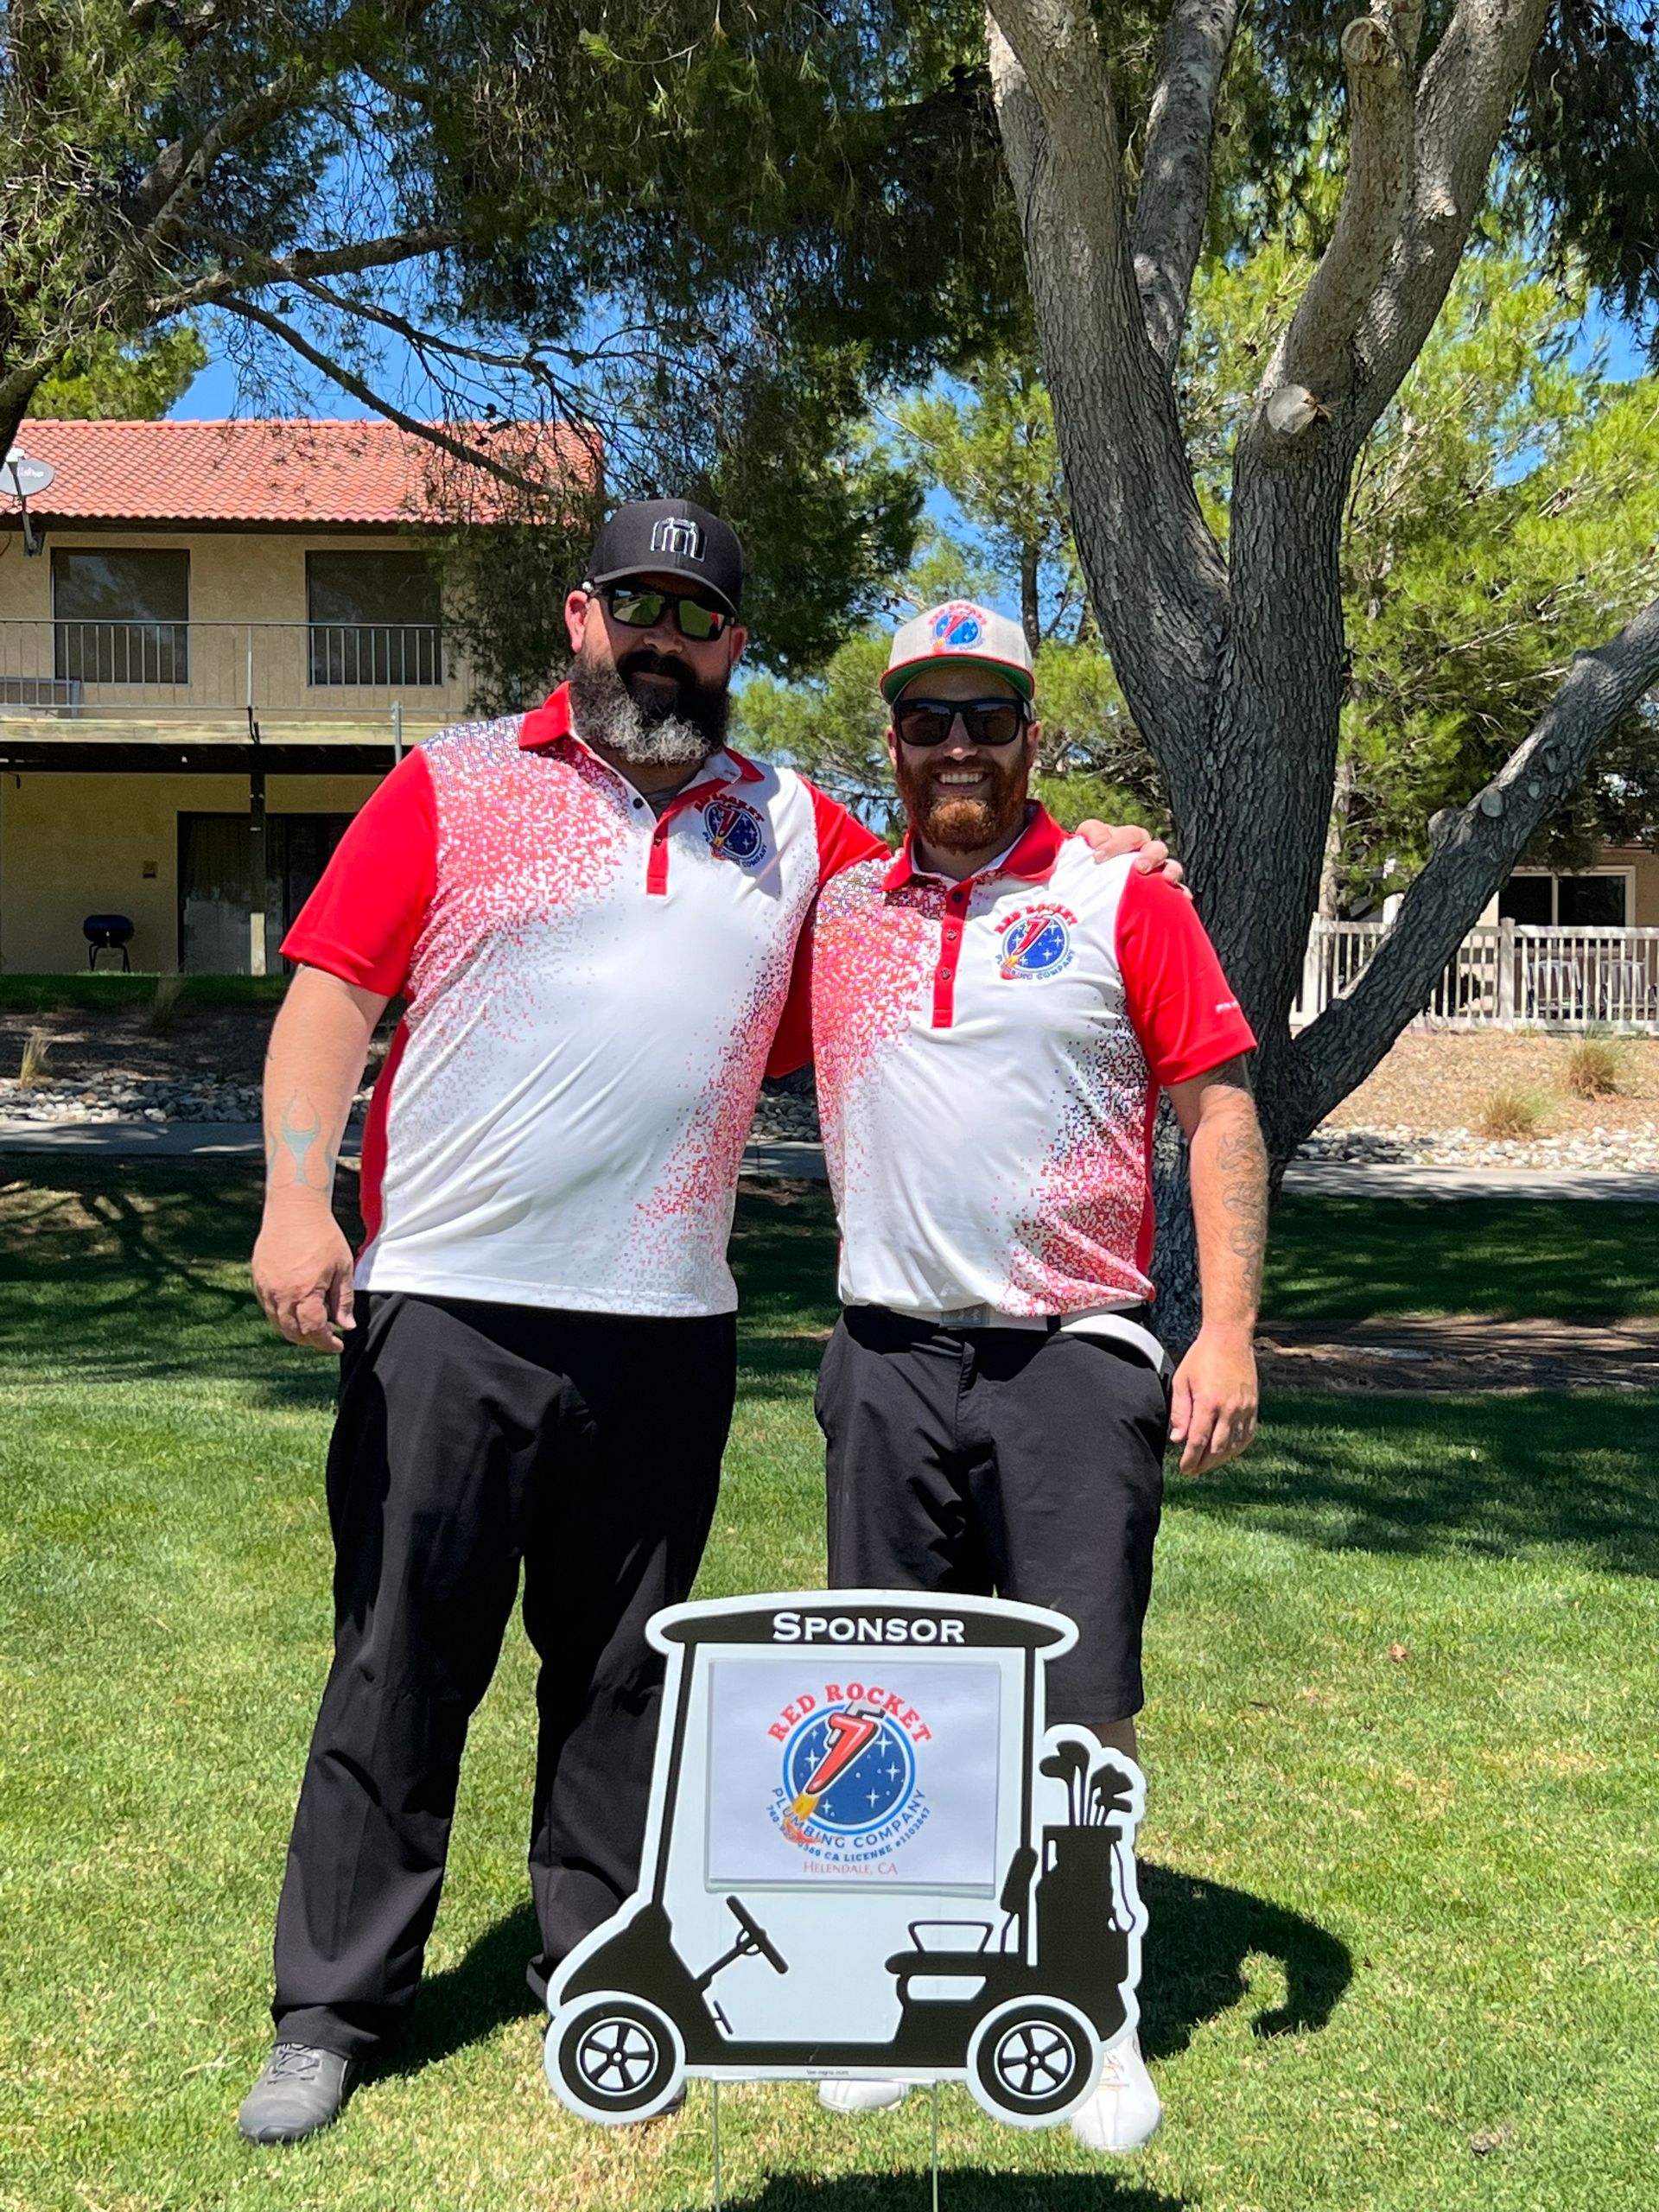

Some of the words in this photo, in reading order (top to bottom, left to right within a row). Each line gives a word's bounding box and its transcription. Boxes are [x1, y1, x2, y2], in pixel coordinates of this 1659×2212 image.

[741, 842, 767, 868] COMPANY
[994, 910, 1022, 935] RED
[1024, 901, 1079, 926] ROCKET
[1036, 949, 1076, 981] COMPANY
[772, 1611, 966, 1644] SPONSOR
[767, 1694, 817, 1742] RED
[824, 1681, 933, 1743] ROCKET
[772, 1787, 846, 1848] PLUMBING
[853, 1789, 926, 1848] COMPANY
[824, 1851, 840, 1862] CA
[877, 1861, 898, 1875] CA
